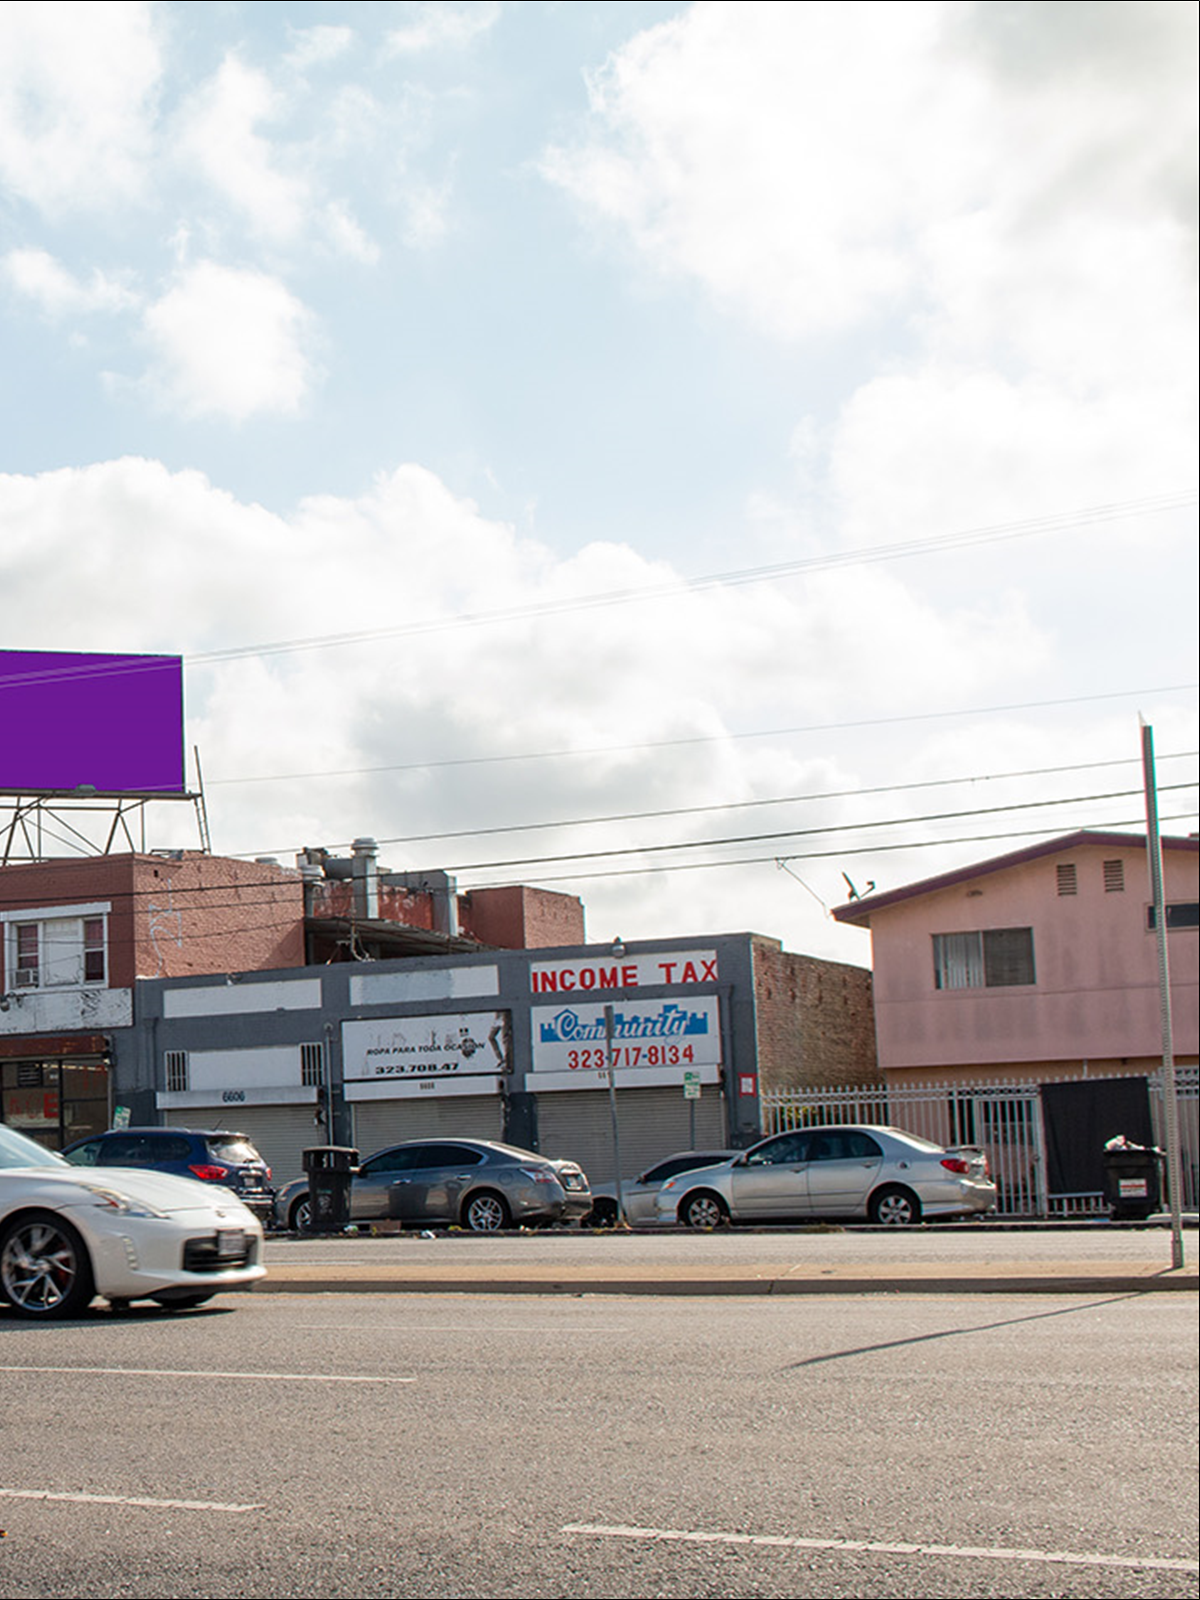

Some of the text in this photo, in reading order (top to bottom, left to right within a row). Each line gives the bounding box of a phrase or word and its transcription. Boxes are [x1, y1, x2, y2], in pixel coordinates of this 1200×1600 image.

[532, 959, 718, 993] INCOME TAX
[367, 1048, 391, 1056] ROPA
[392, 1047, 416, 1055] PARA
[418, 1045, 442, 1053] TODA
[568, 1044, 694, 1070] 323-717-8134
[375, 1063, 459, 1075] 323.708.47
